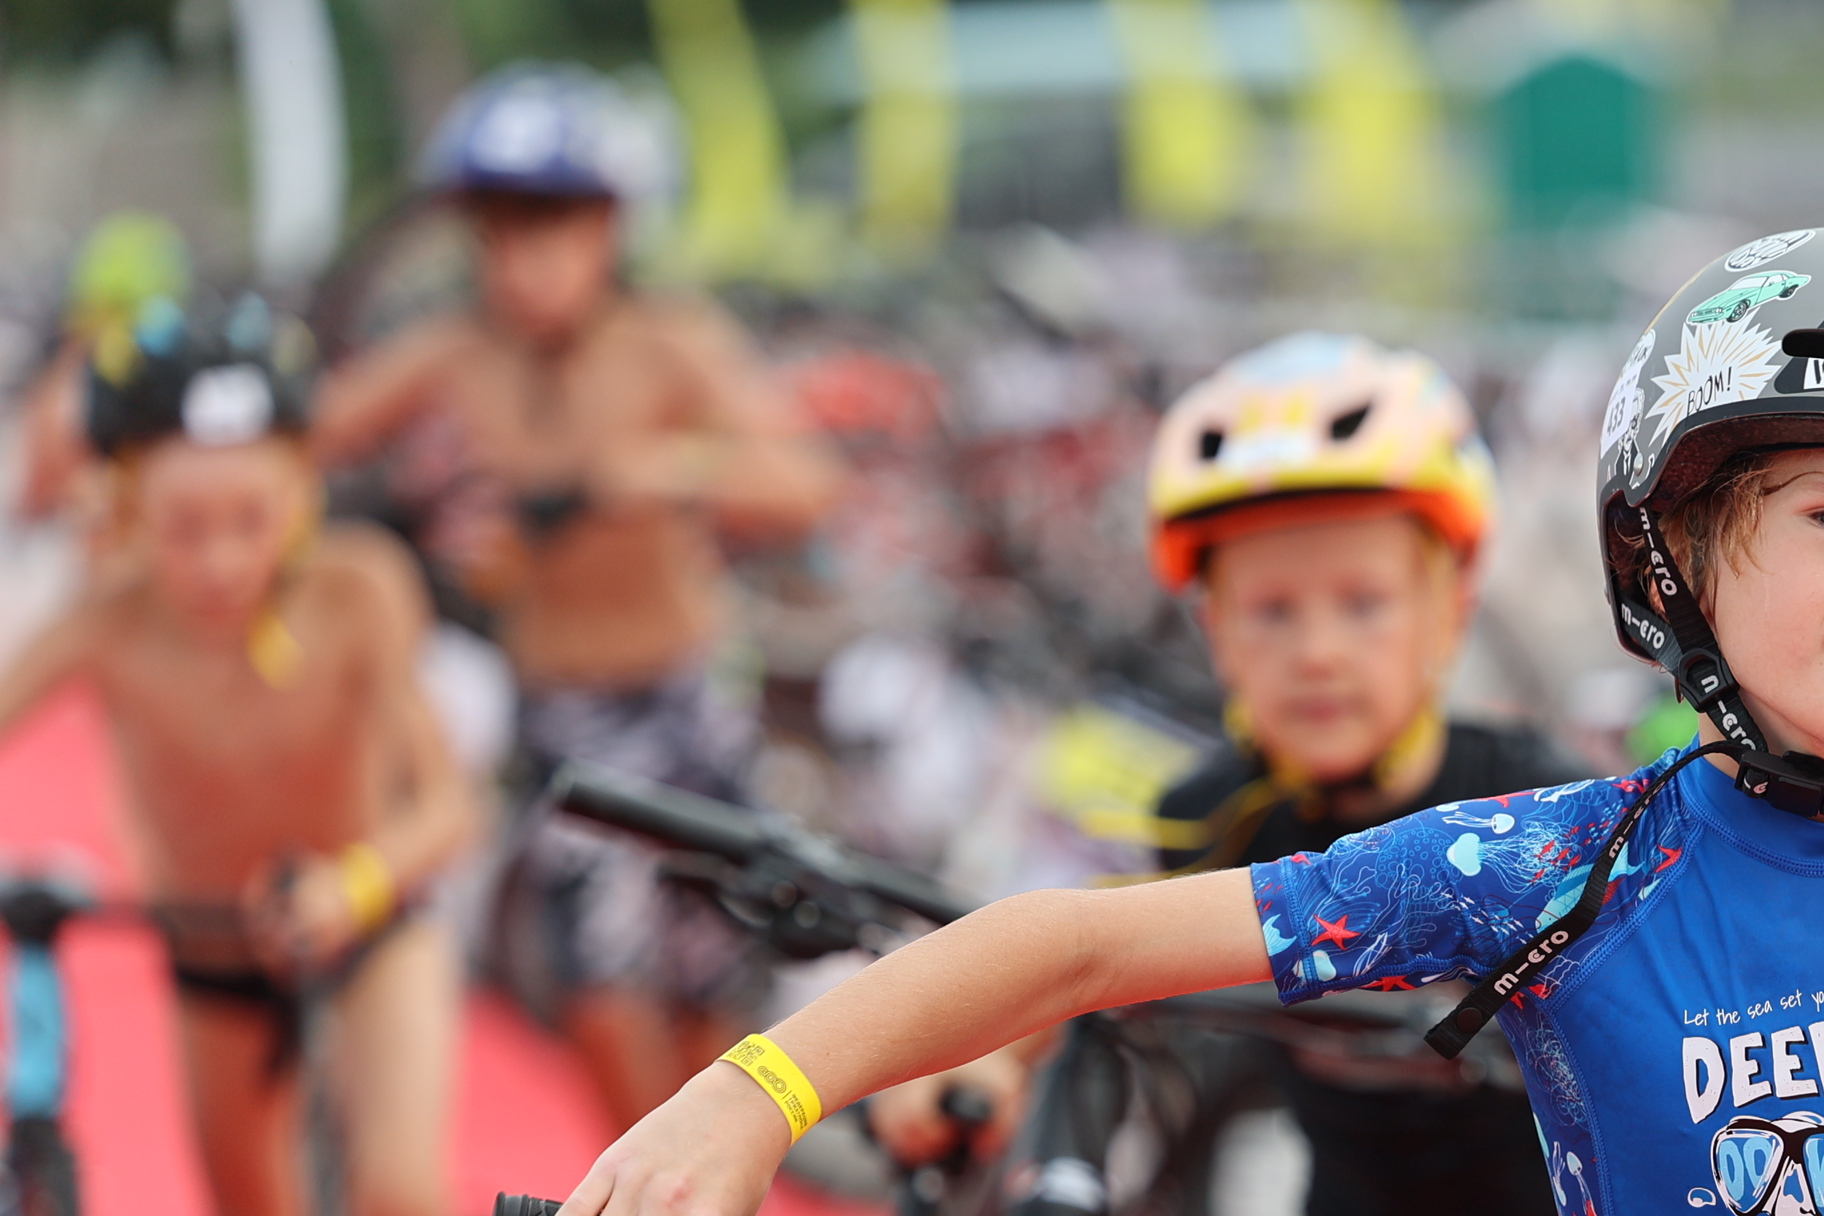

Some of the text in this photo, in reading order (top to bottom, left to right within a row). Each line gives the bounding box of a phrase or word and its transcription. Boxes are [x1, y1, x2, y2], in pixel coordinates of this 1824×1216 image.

[1687, 366, 1732, 417] BOOM!
[1683, 1008, 1710, 1026] Let
[1716, 1008, 1741, 1026] the
[1747, 1000, 1773, 1019] sea
[1779, 989, 1803, 1010] set
